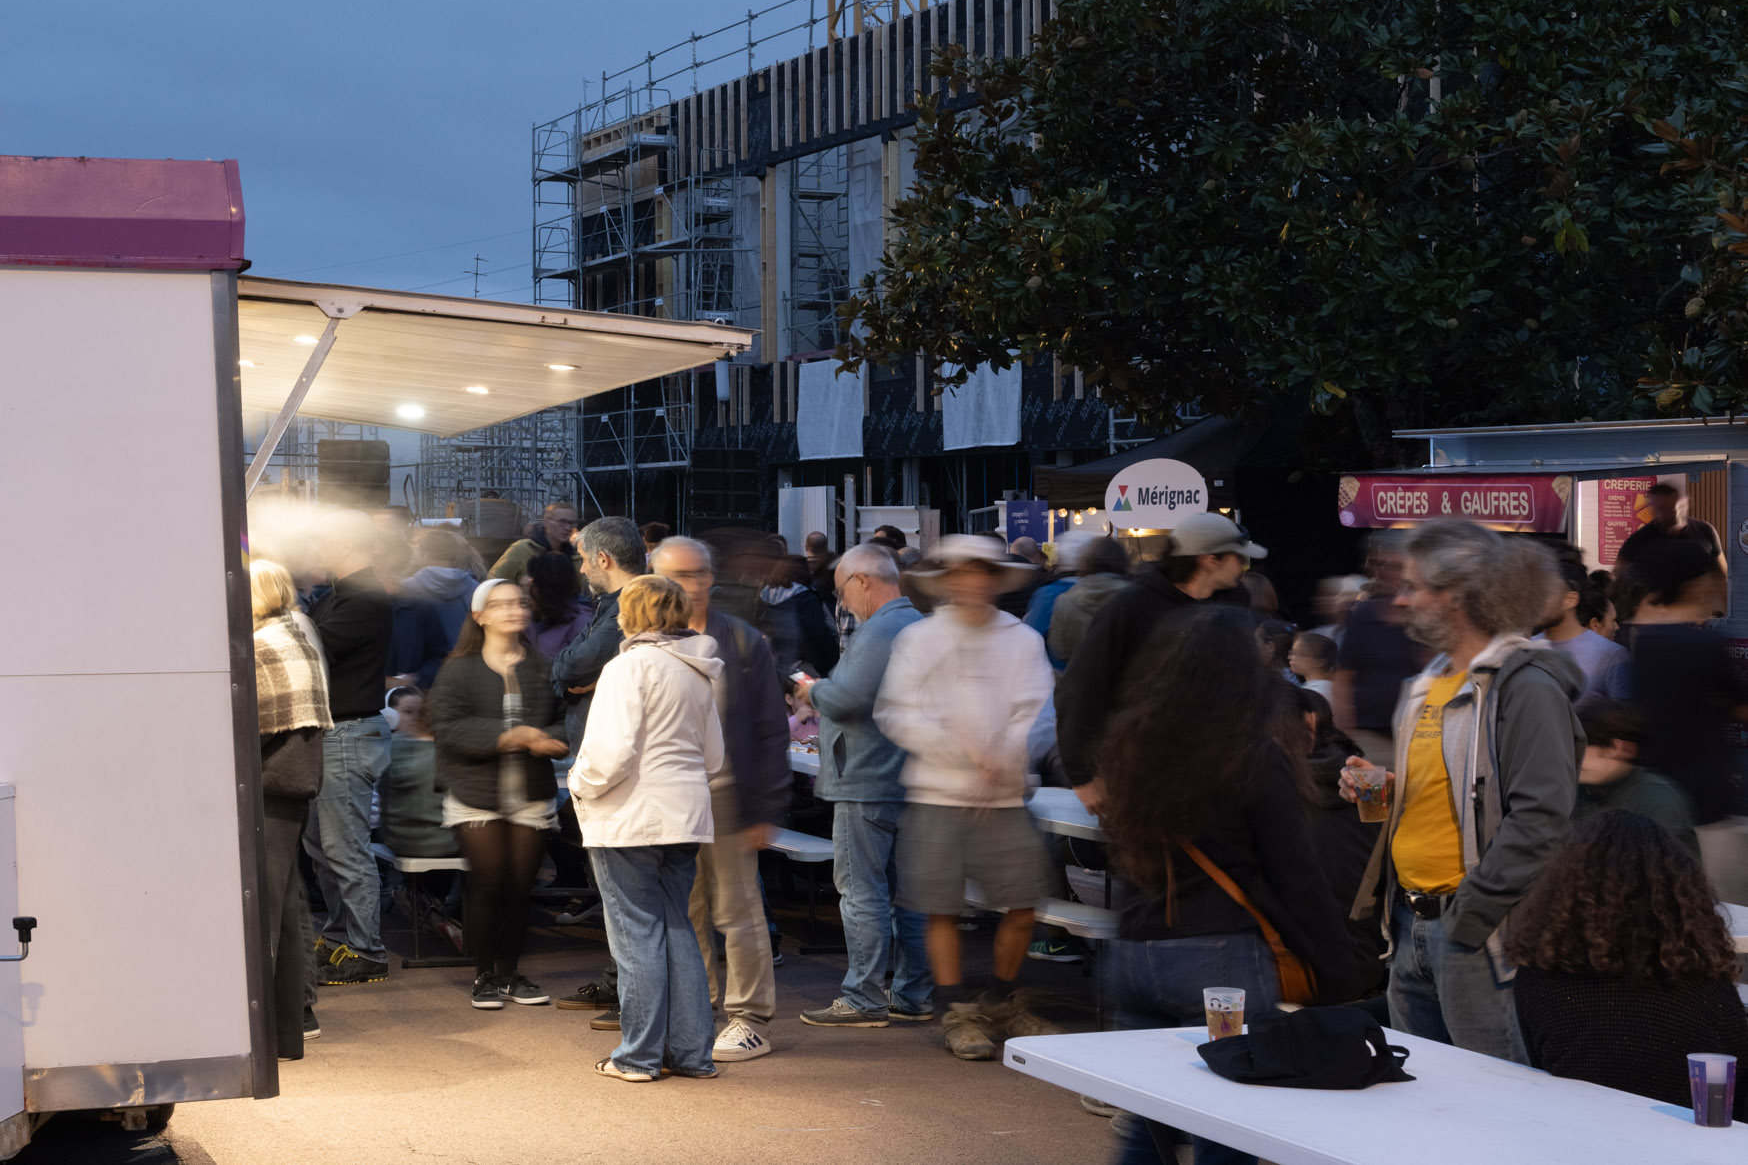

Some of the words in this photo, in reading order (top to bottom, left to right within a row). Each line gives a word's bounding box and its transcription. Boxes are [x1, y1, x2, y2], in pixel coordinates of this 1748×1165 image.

[1138, 485, 1200, 510] Mérignac
[1604, 479, 1652, 491] CREPERIE
[1377, 486, 1429, 514] CRÊPES
[1441, 491, 1452, 514] &
[1461, 491, 1529, 516] GAUFRES
